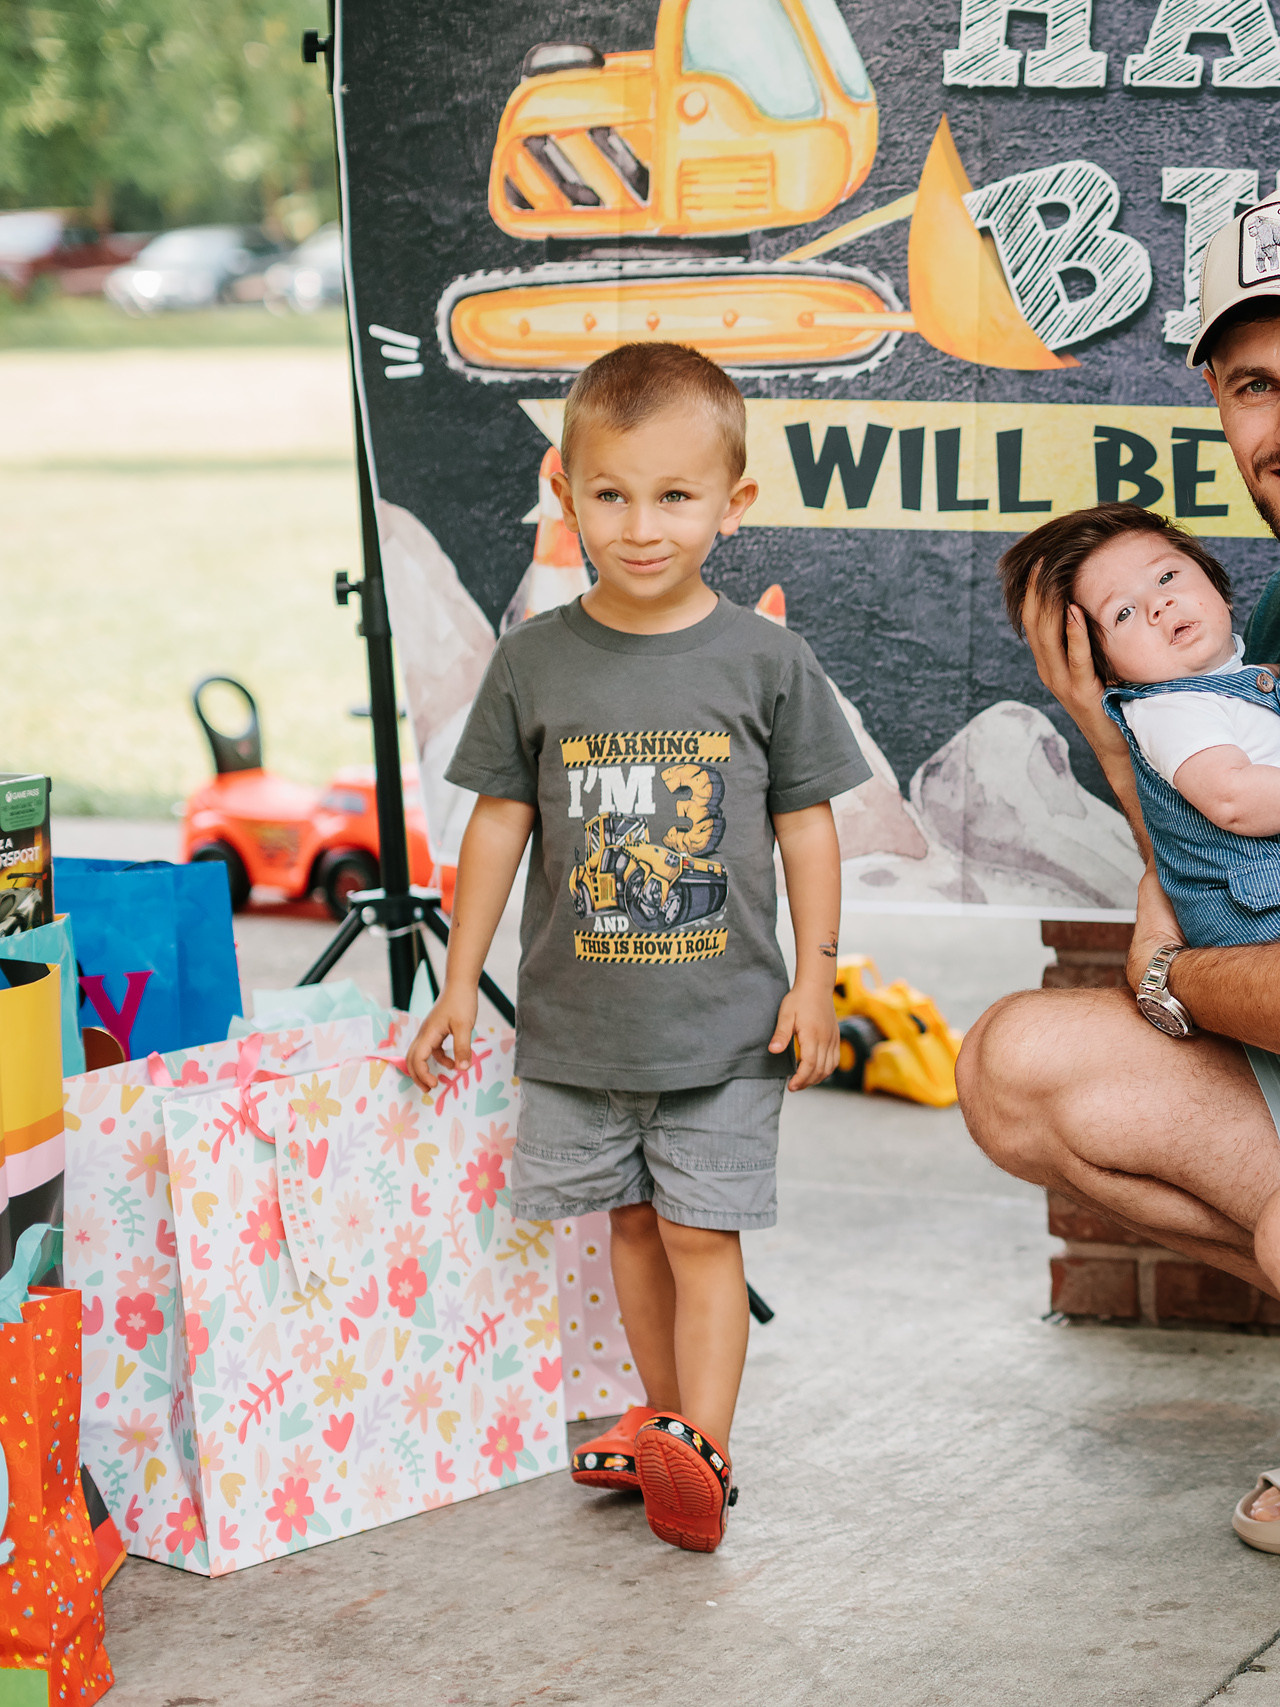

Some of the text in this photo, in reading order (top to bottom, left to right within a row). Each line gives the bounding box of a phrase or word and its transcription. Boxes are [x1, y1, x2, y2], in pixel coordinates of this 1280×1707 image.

[784, 421, 1052, 514] WILL
[1093, 424, 1229, 518] BE
[586, 736, 700, 759] WARNING
[567, 762, 727, 858] I'M 3
[593, 915, 630, 934] AND
[580, 935, 720, 956] THIS IS HOW I ROLL
